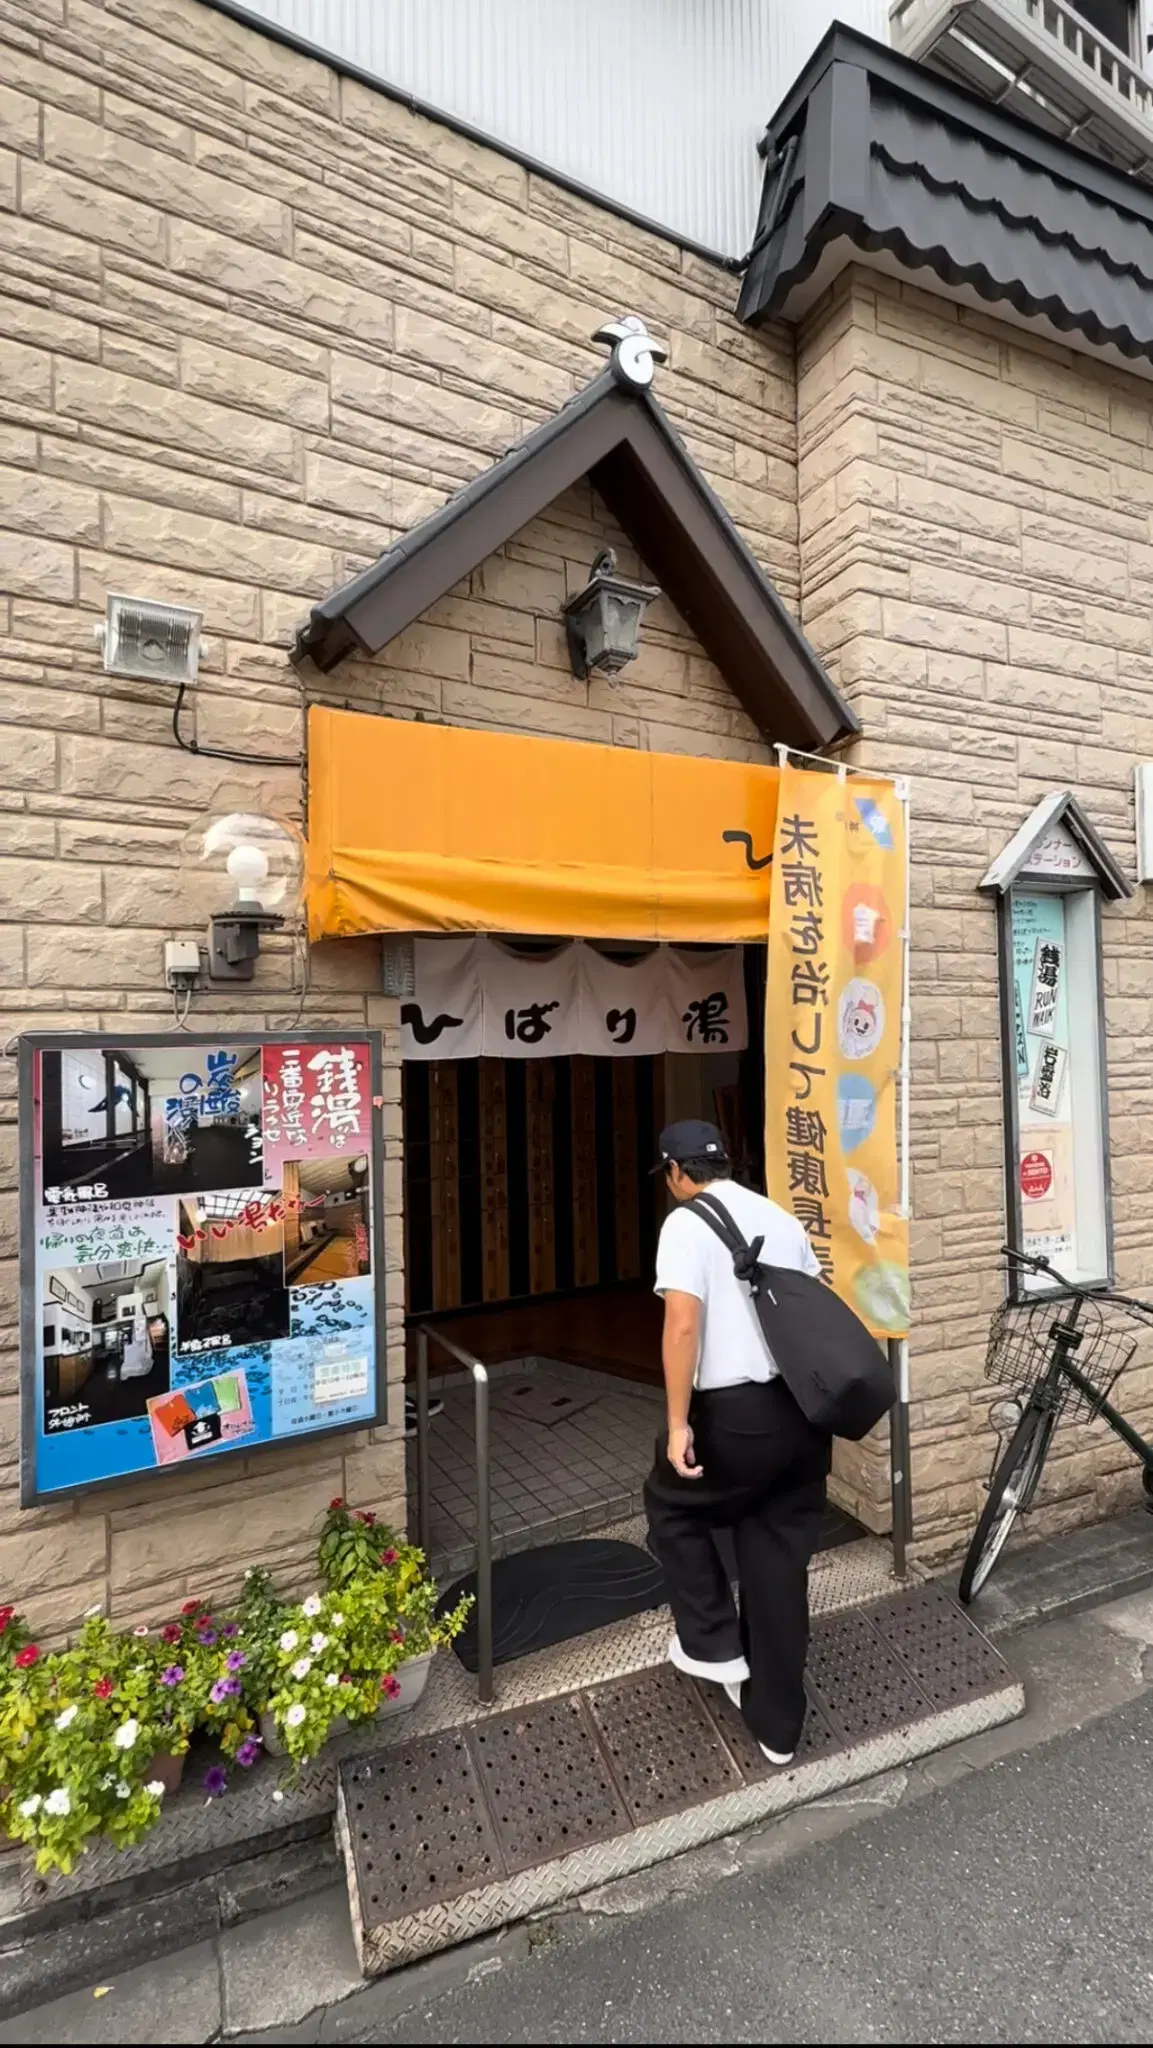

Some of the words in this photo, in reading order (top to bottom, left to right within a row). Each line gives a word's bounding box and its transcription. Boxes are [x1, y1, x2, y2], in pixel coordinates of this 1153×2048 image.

[1034, 988, 1058, 1010] RUN
[401, 992, 732, 1045] ひばり湯
[307, 1046, 363, 1149] 銭湯は
[48, 1402, 90, 1418] フロント
